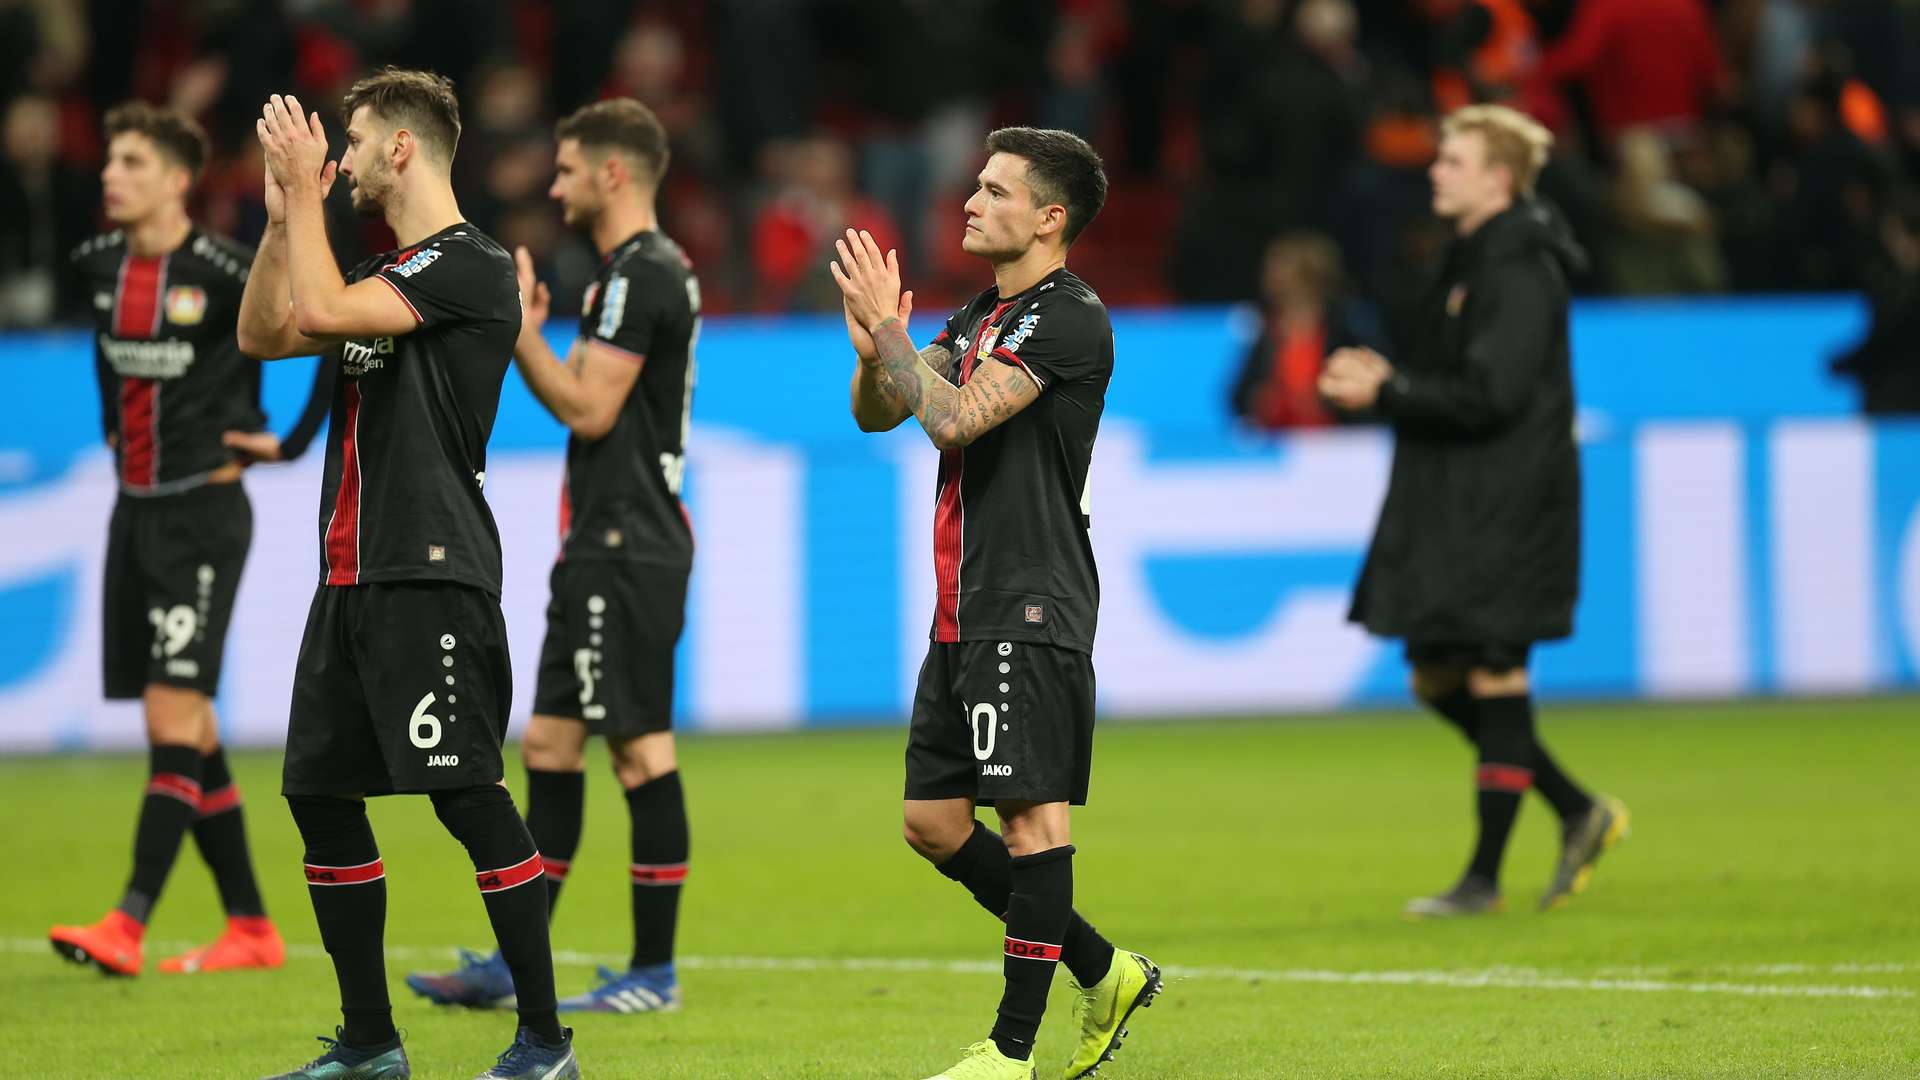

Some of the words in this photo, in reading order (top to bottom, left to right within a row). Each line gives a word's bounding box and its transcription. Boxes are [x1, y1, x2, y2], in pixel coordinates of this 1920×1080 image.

[409, 691, 442, 749] 6
[962, 700, 998, 761] 0
[427, 754, 460, 768] JAKO
[981, 764, 1013, 777] JAKO
